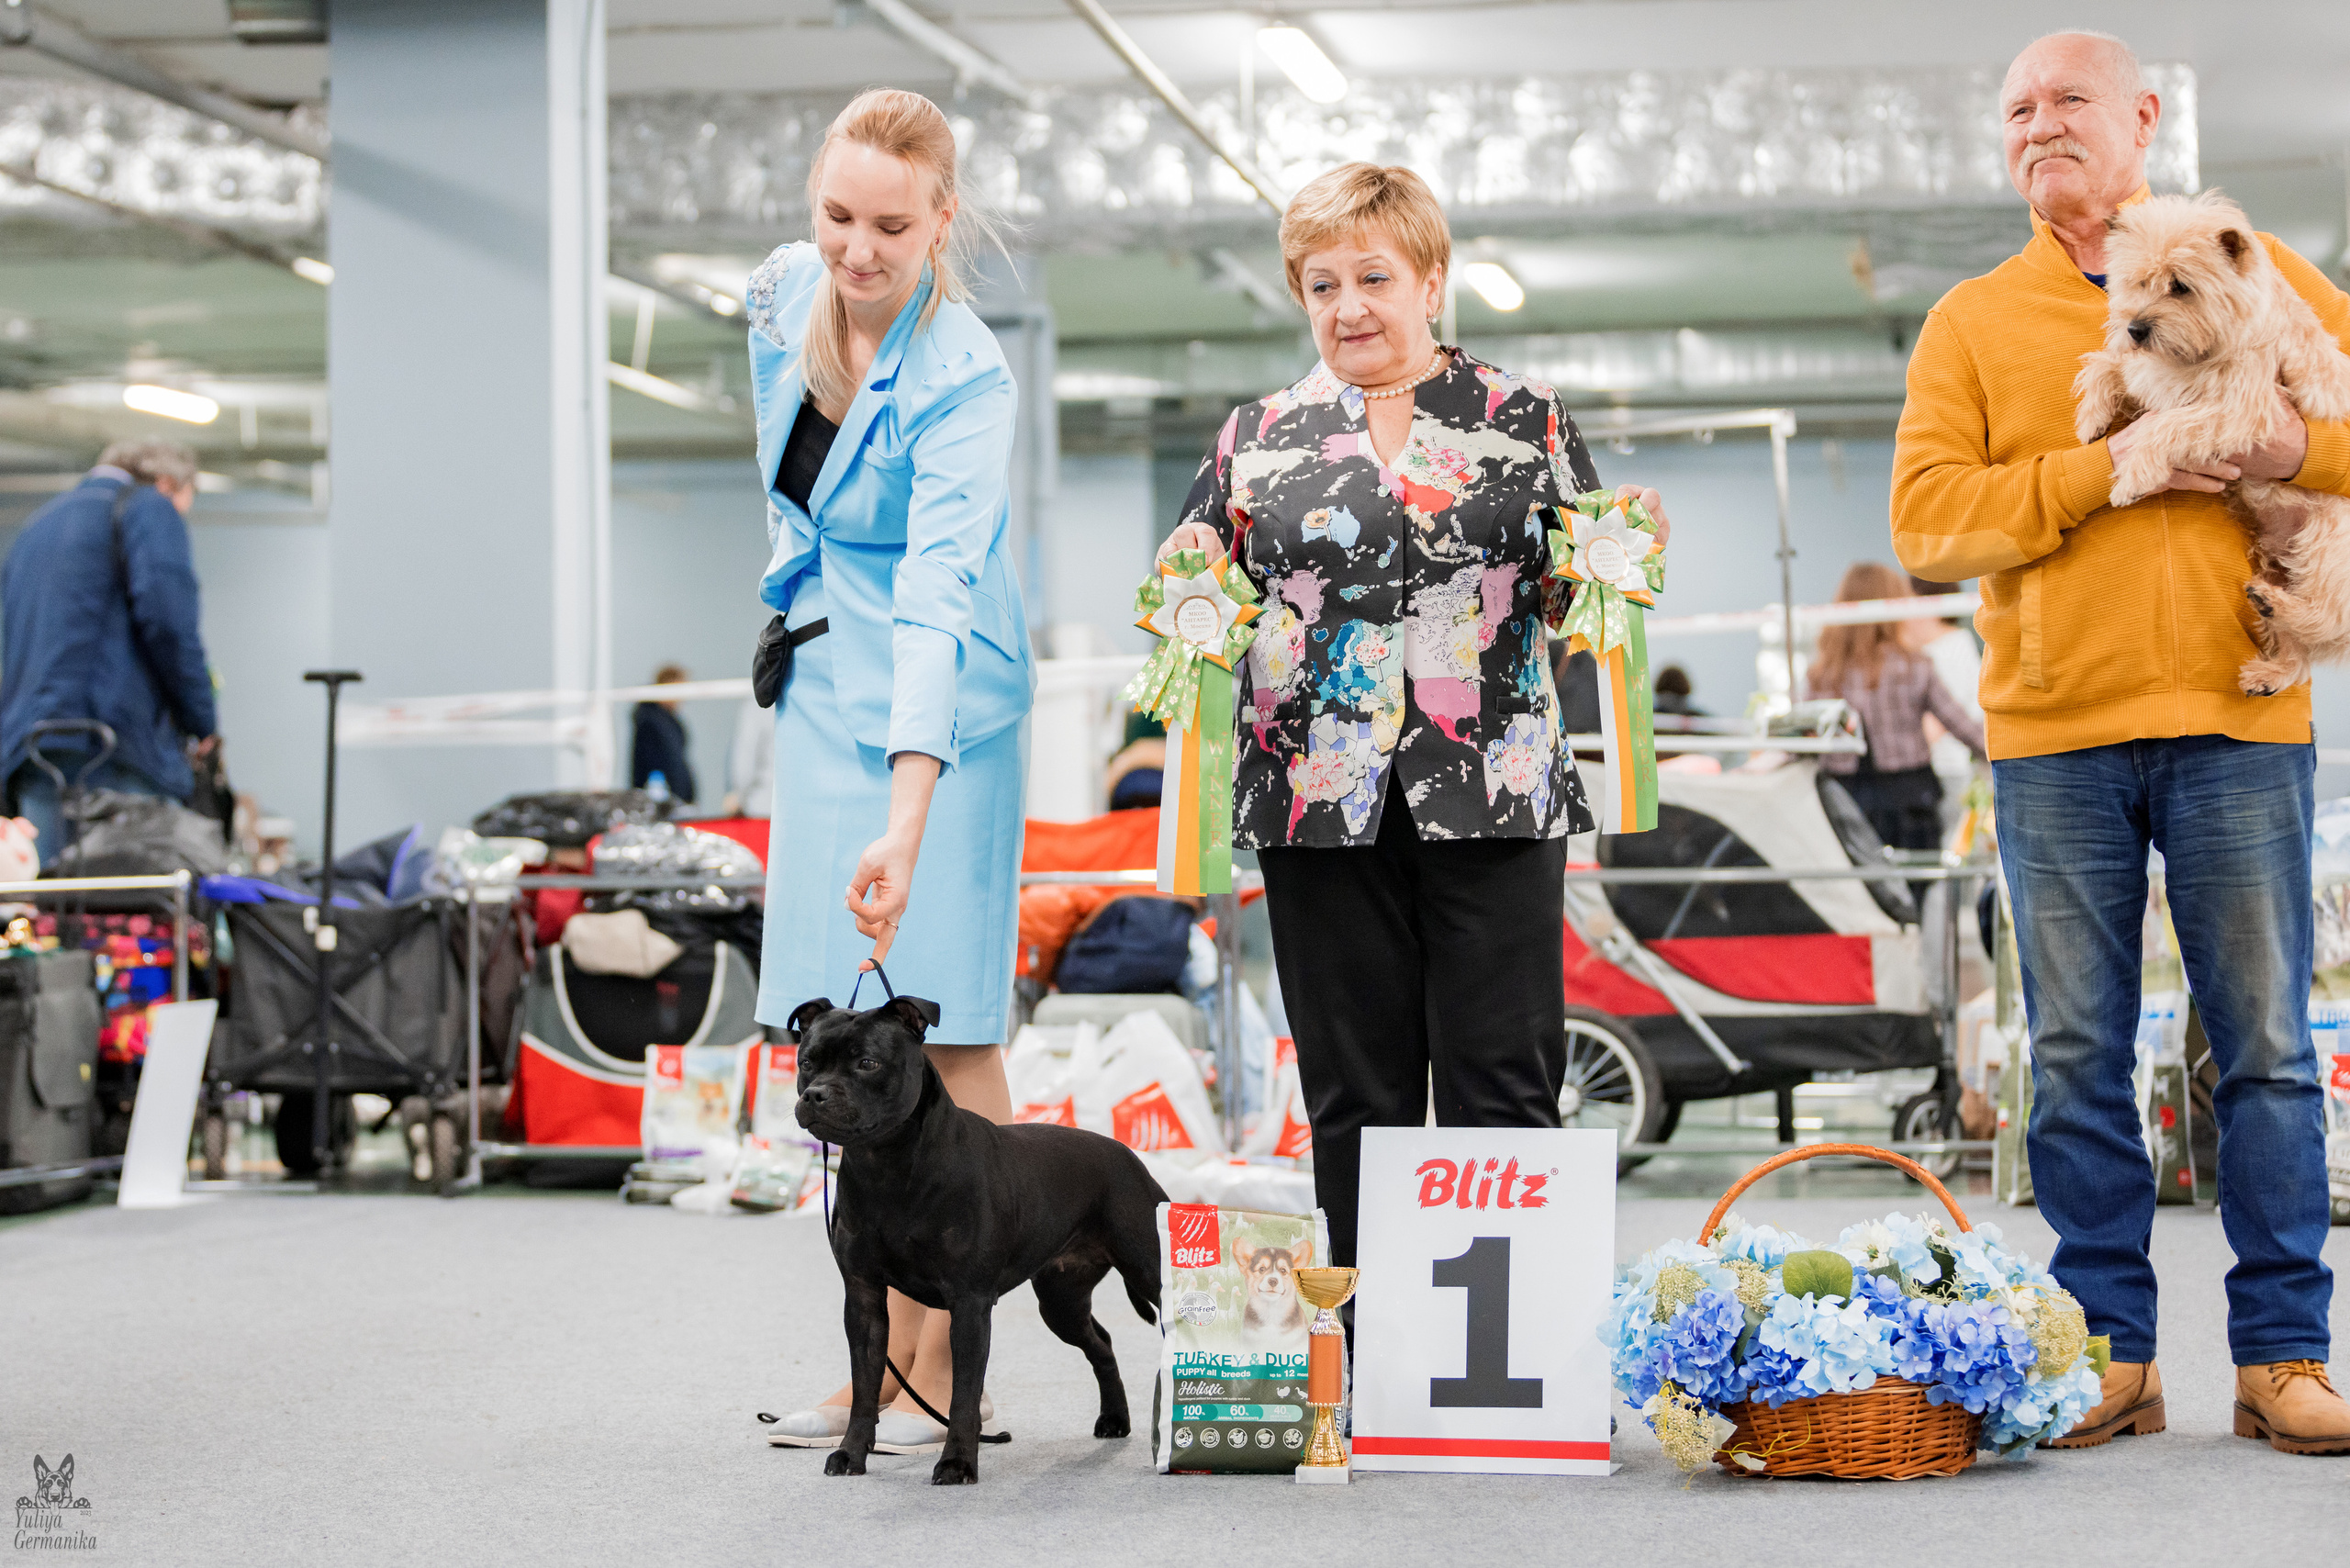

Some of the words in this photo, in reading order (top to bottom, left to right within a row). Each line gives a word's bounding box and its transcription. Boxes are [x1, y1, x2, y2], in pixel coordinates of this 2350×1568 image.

[1629, 674, 1652, 783] WINNER
[1207, 738, 1227, 847] WINNER
[1175, 1246, 1215, 1264] Blitz
[1178, 1305, 1216, 1315] GrainFree
[1429, 1236, 1544, 1408] 1
[1173, 1351, 1245, 1367] TURKEY
[1249, 1352, 1260, 1366] &
[1176, 1367, 1205, 1377] PUPPY
[1206, 1369, 1217, 1377] all
[1221, 1370, 1251, 1378] breeds
[1283, 1369, 1295, 1378] 12
[1178, 1381, 1225, 1396] Holistic
